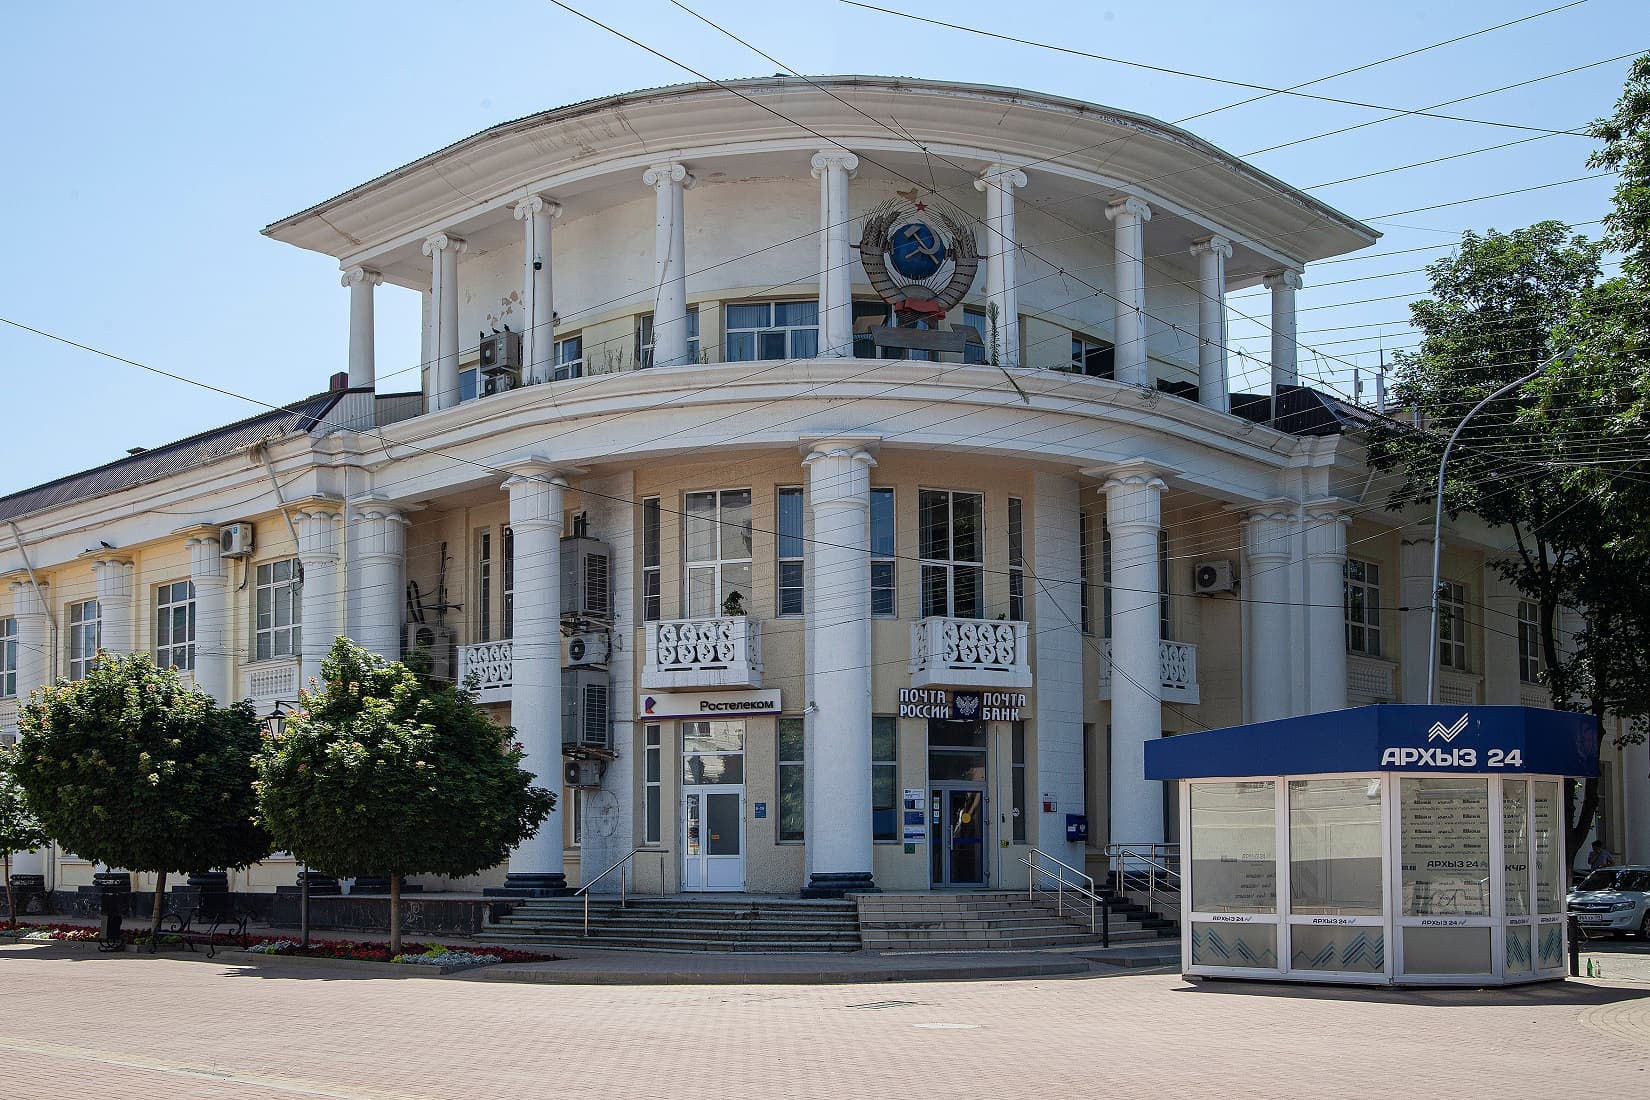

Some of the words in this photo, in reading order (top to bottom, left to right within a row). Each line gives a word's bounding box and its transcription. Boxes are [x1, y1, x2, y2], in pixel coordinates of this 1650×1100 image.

[899, 688, 946, 704] ПОЧТА
[983, 692, 1026, 707] ПОЧТА
[699, 700, 774, 712] Ростелеком
[899, 704, 949, 719] РОССИИ
[982, 707, 1020, 721] БАНК
[1381, 747, 1477, 767] АРХЫЗ
[1487, 748, 1523, 767] 24
[1427, 860, 1465, 868] АРХЫЗ
[1466, 860, 1479, 868] 24
